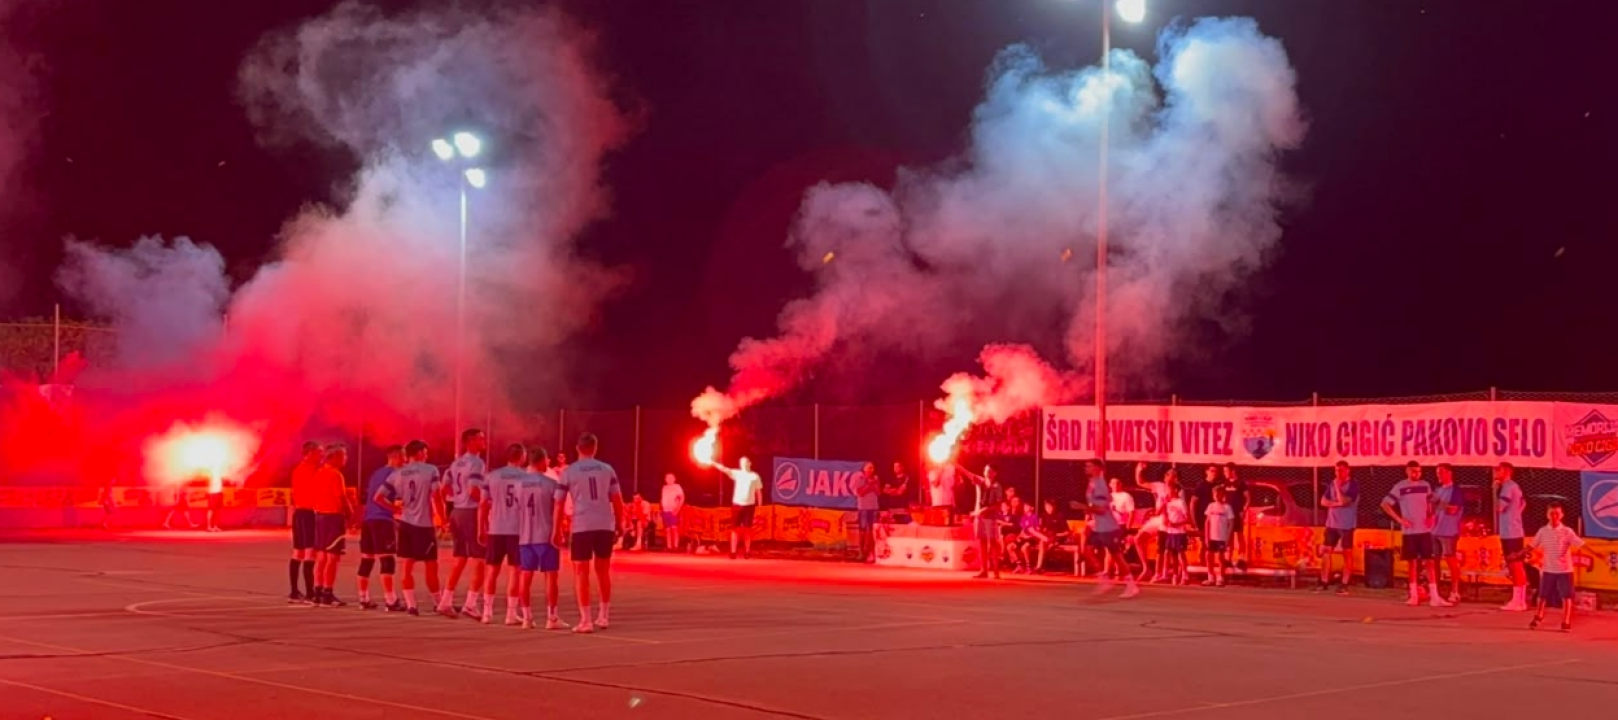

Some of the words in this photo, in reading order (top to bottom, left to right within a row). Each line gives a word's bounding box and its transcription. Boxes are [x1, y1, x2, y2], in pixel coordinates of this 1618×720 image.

[1046, 413, 1082, 451] ŠRD
[1179, 421, 1234, 456] VITEZ
[1285, 422, 1332, 458] NIKO
[1336, 413, 1395, 458] CIGIĆ
[1401, 418, 1488, 457] PAKOVO
[1492, 417, 1546, 458] SELO
[506, 483, 515, 507] 5
[526, 492, 535, 517] 4
